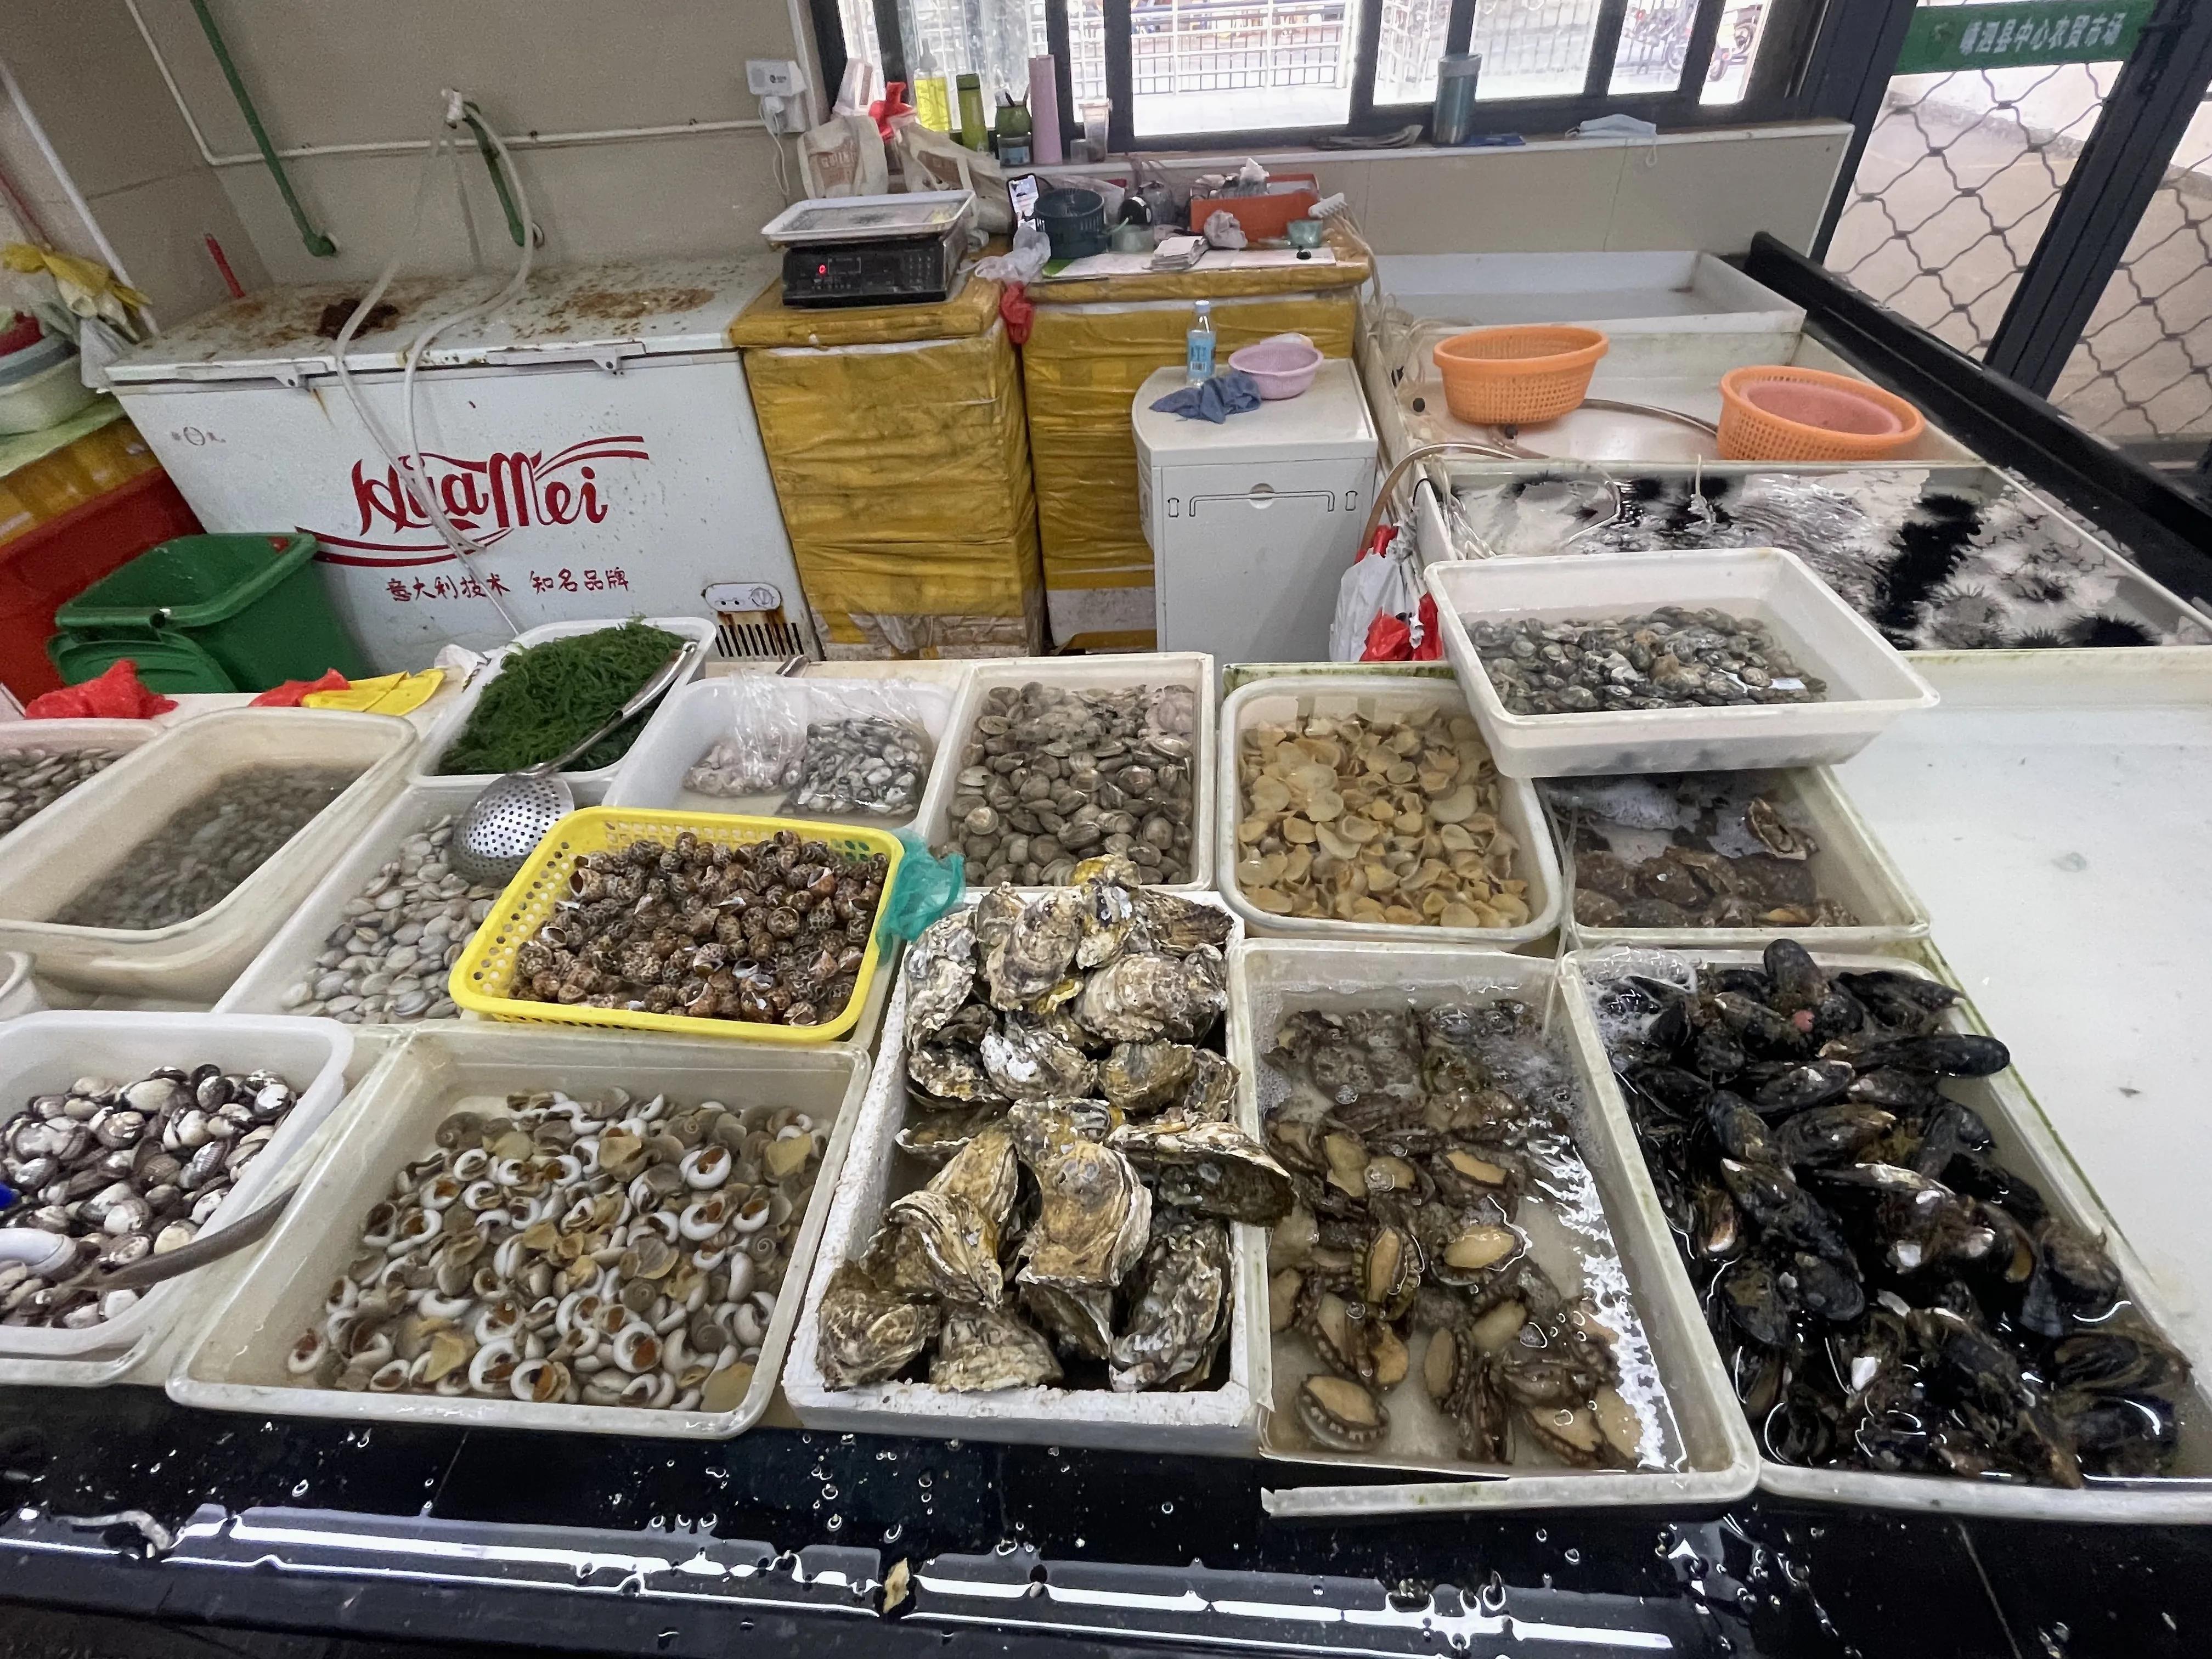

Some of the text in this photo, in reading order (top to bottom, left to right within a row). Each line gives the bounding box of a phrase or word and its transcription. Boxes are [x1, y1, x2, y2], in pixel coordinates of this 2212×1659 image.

[386, 567, 629, 601] 意大利技术 知名品牌
